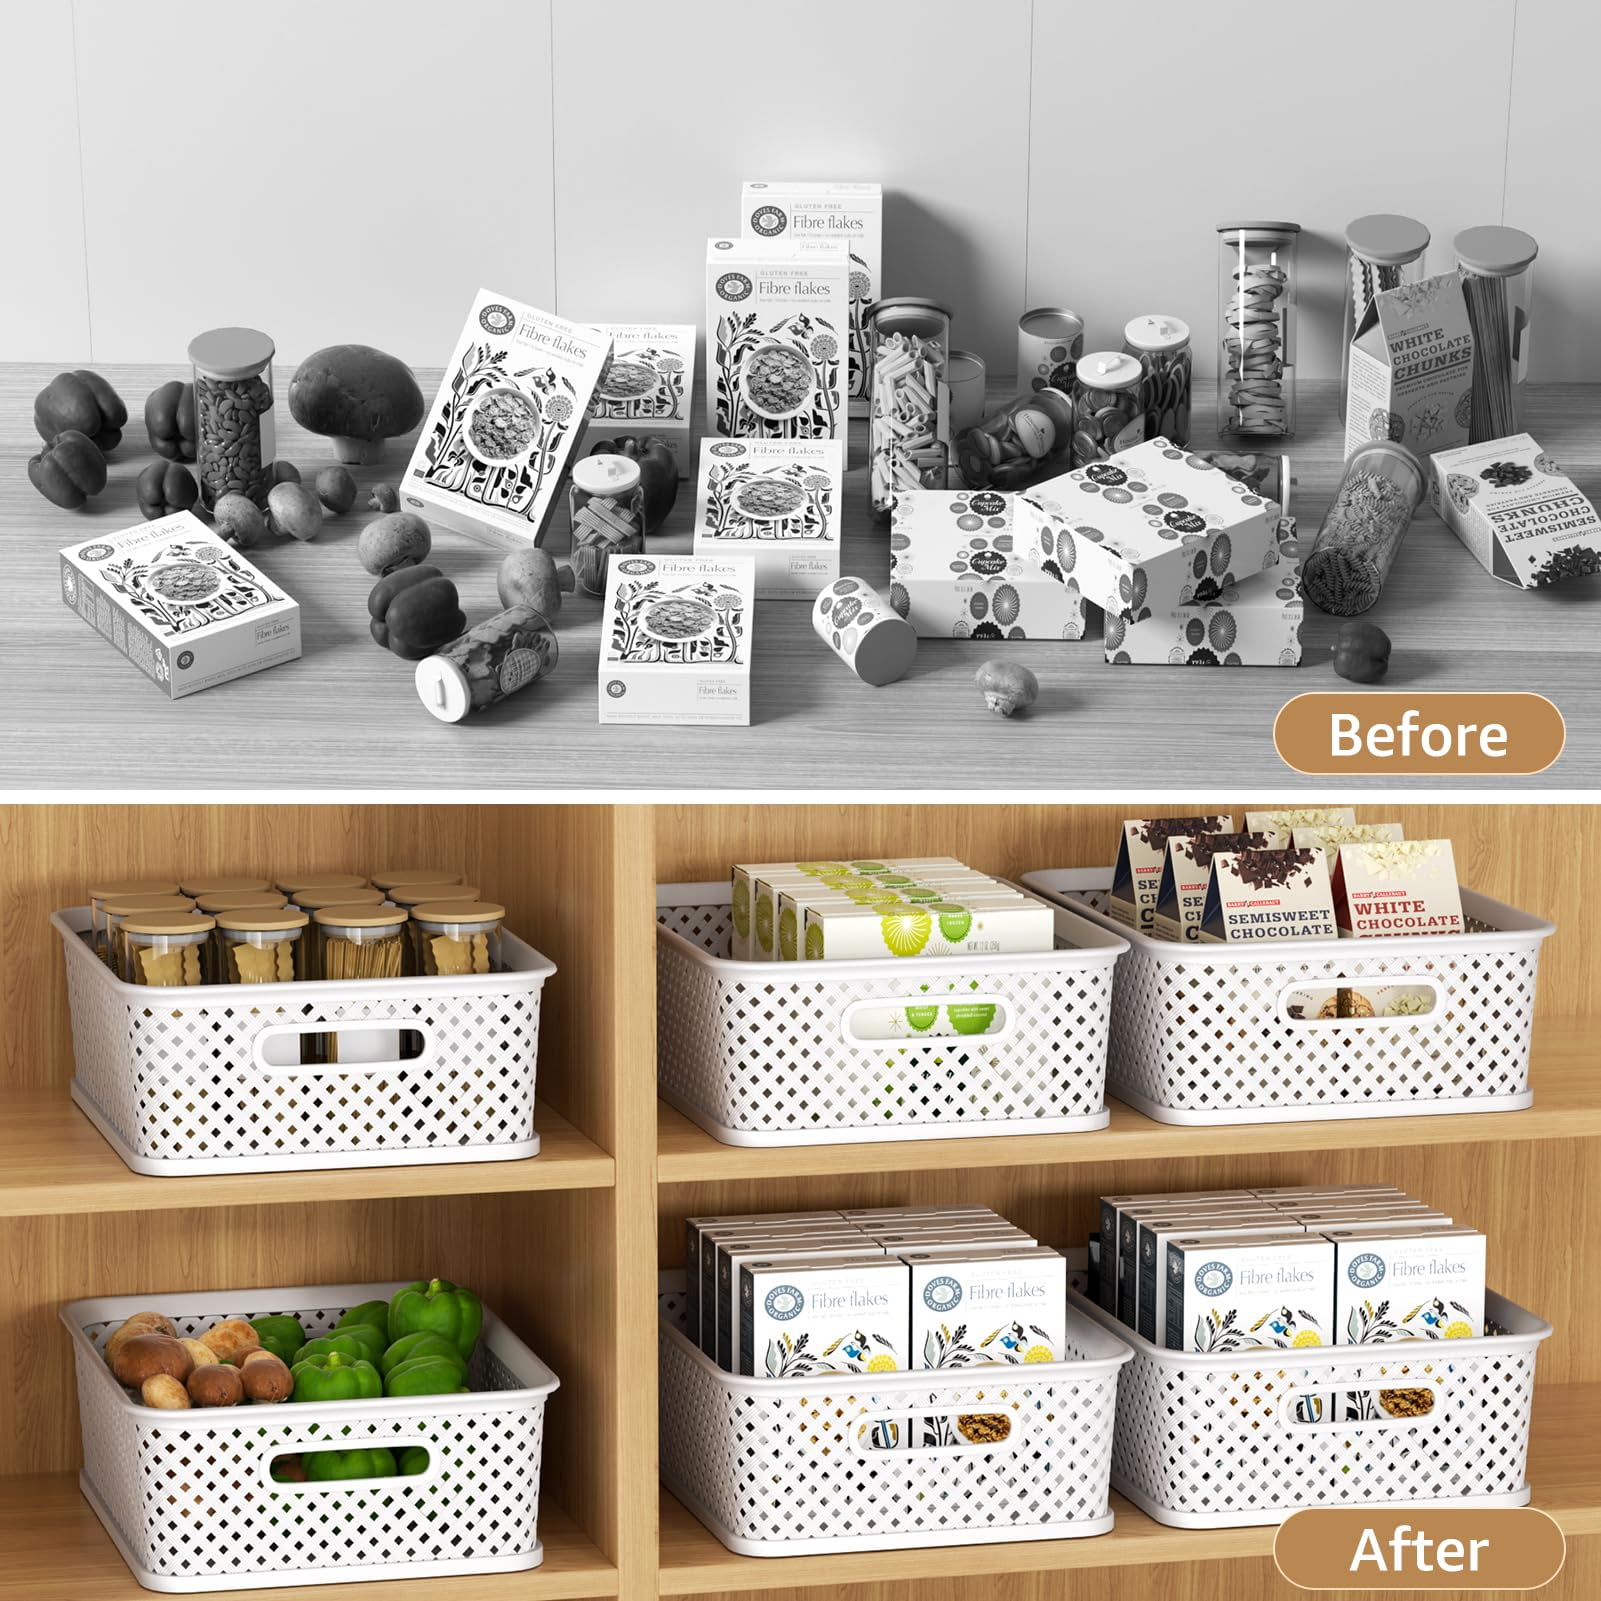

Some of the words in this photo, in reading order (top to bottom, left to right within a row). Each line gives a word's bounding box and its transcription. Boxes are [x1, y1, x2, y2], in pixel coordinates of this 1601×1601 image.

[793, 214, 825, 229] Fibre
[828, 214, 864, 229] flakes
[759, 280, 791, 295] Fibre
[794, 280, 831, 295] flakes
[519, 323, 551, 345] Fibre
[552, 335, 588, 359] flakes
[1390, 328, 1445, 353] WHITE
[1393, 334, 1472, 366] CHOCOLATE
[1394, 347, 1472, 380] CHUNKS
[753, 446, 785, 455] Fibre
[788, 446, 825, 455] flakes
[1491, 496, 1585, 524] CHUNKS
[1498, 505, 1591, 533] CHOCOLATE
[117, 535, 148, 549] Fibre
[150, 524, 185, 538] flakes
[1505, 515, 1597, 543] SEMISWEET
[662, 563, 696, 572] Fibre
[699, 564, 737, 573] flakes
[699, 686, 717, 695] Fibre
[717, 686, 737, 696] flakes
[1228, 909, 1331, 925] SEMISWEET
[1354, 900, 1426, 915] WHITE
[1230, 924, 1334, 939] CHOCOLATE
[1356, 915, 1460, 930] CHOCOLATE
[1240, 1268, 1273, 1285] Fibre
[1277, 1266, 1314, 1283] flakes
[1393, 1260, 1425, 1277] Fibre
[1429, 1258, 1466, 1275] flakes
[811, 1292, 846, 1309] Fibre
[849, 1288, 889, 1307] flakes
[969, 1283, 1004, 1300] Fibre
[1007, 1281, 1046, 1298] flakes
